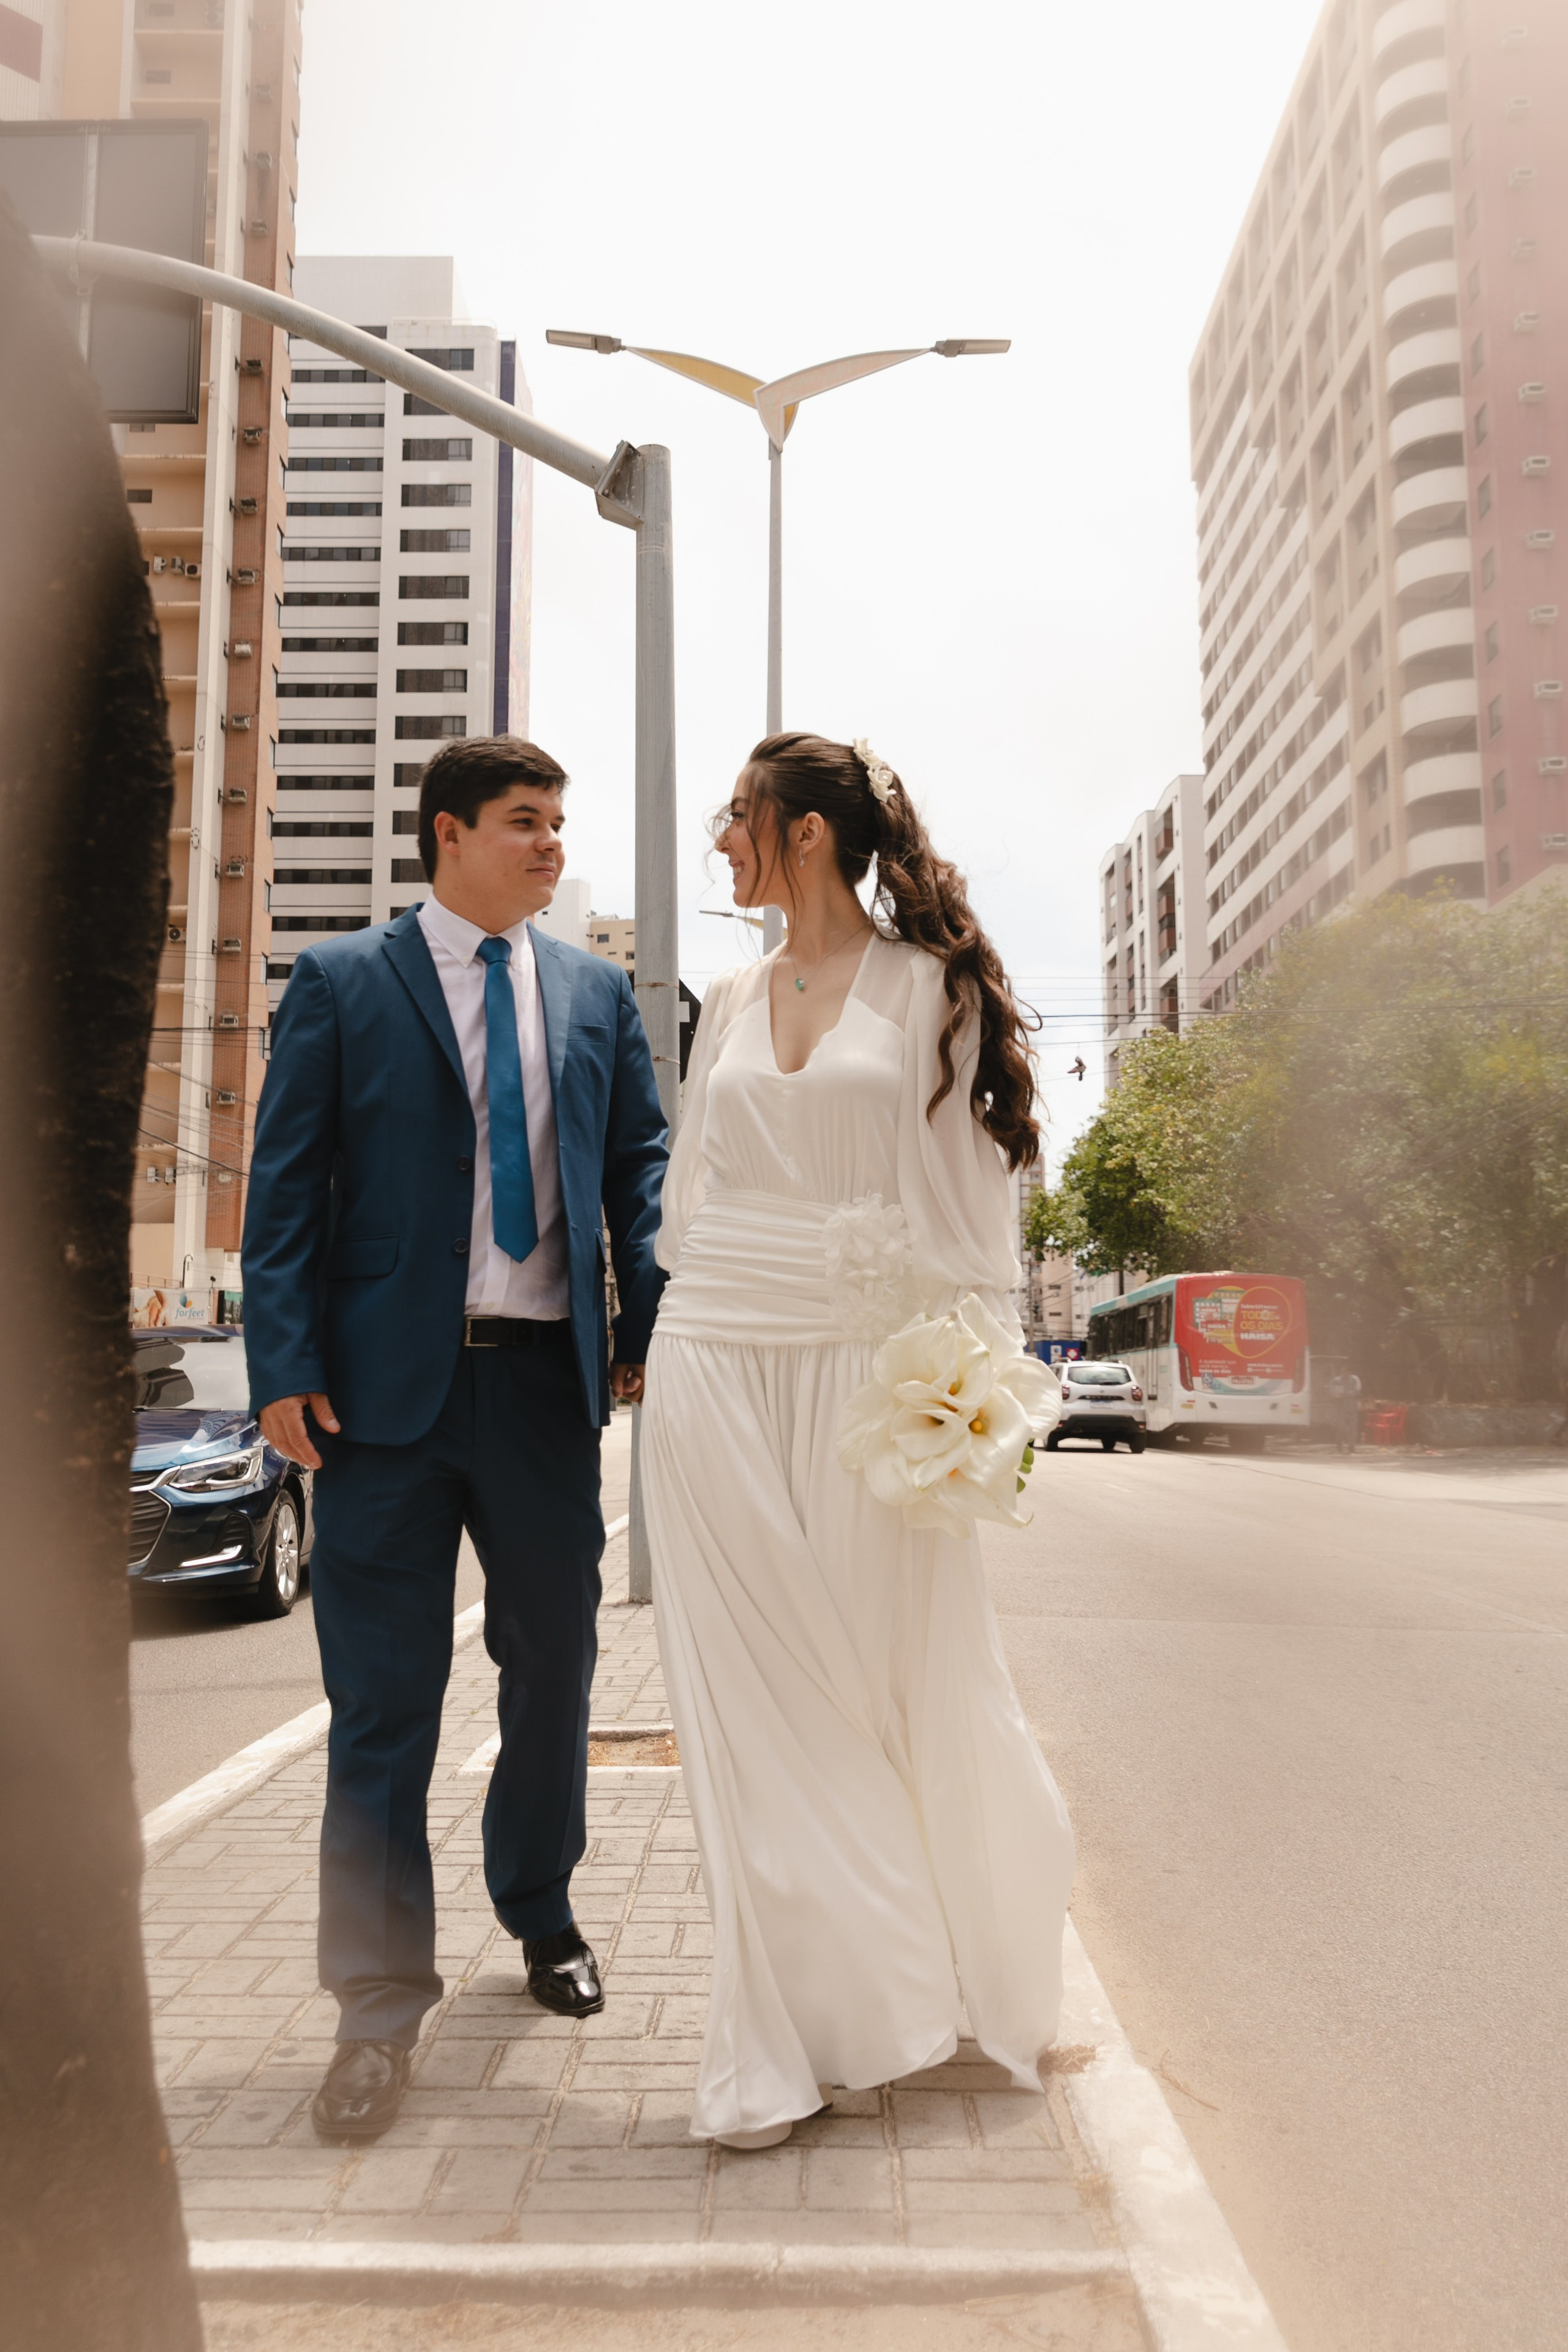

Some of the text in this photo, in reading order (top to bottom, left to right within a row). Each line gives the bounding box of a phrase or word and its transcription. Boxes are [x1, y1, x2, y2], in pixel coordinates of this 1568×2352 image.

[1240, 1310, 1276, 1321] TODOS
[1240, 1321, 1284, 1330] OS DIAS
